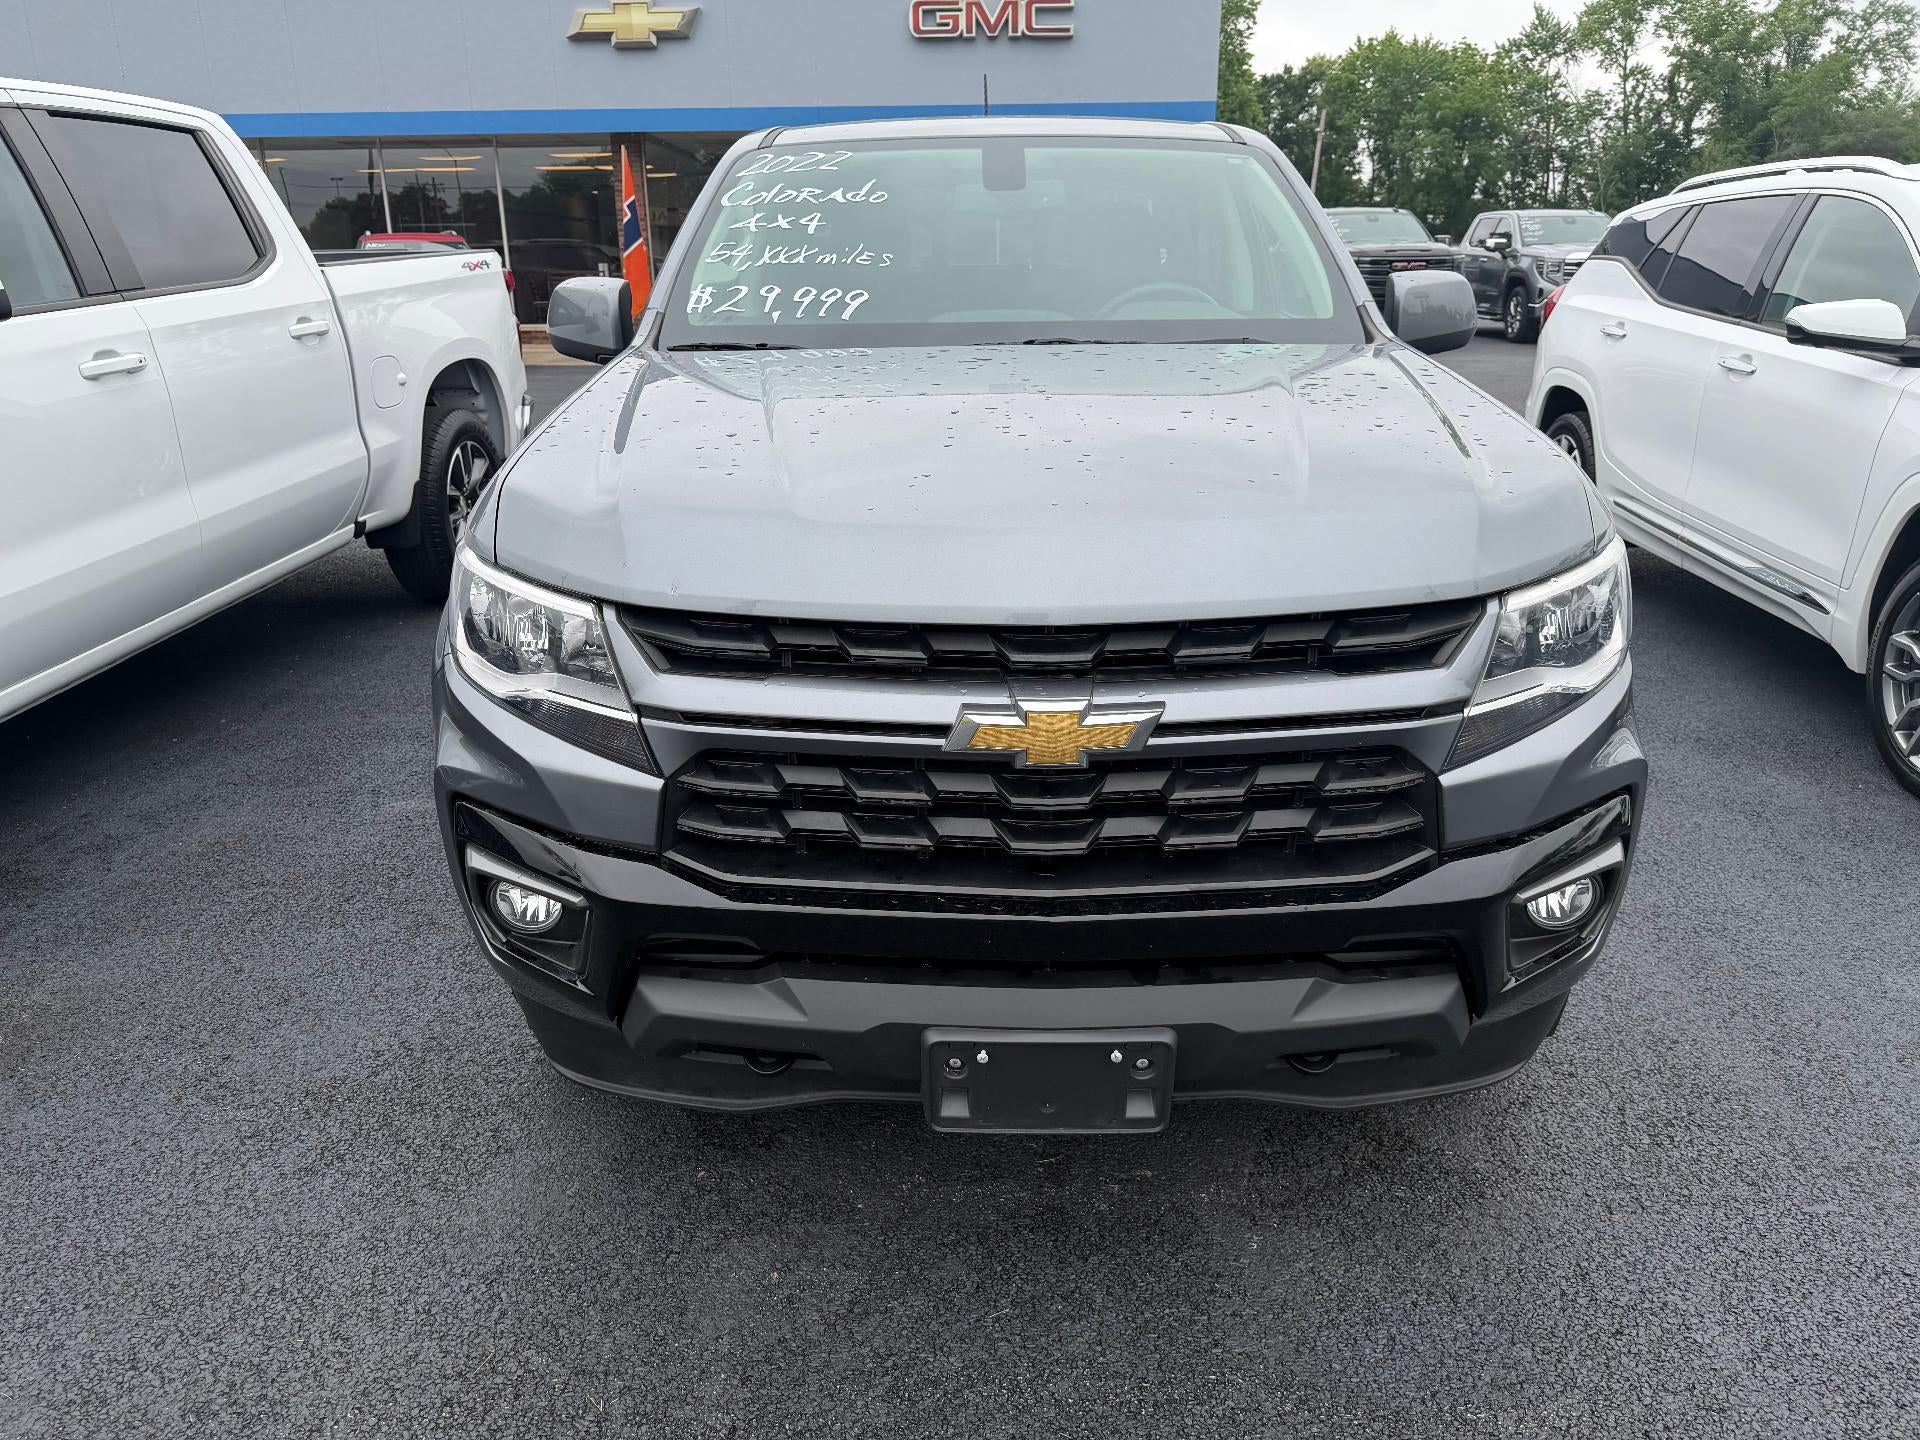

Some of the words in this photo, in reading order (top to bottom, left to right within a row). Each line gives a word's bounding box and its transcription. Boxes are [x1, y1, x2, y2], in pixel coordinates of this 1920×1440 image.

[909, 0, 1074, 39] GMC
[736, 151, 853, 176] 2022
[686, 283, 870, 323] $29,999
